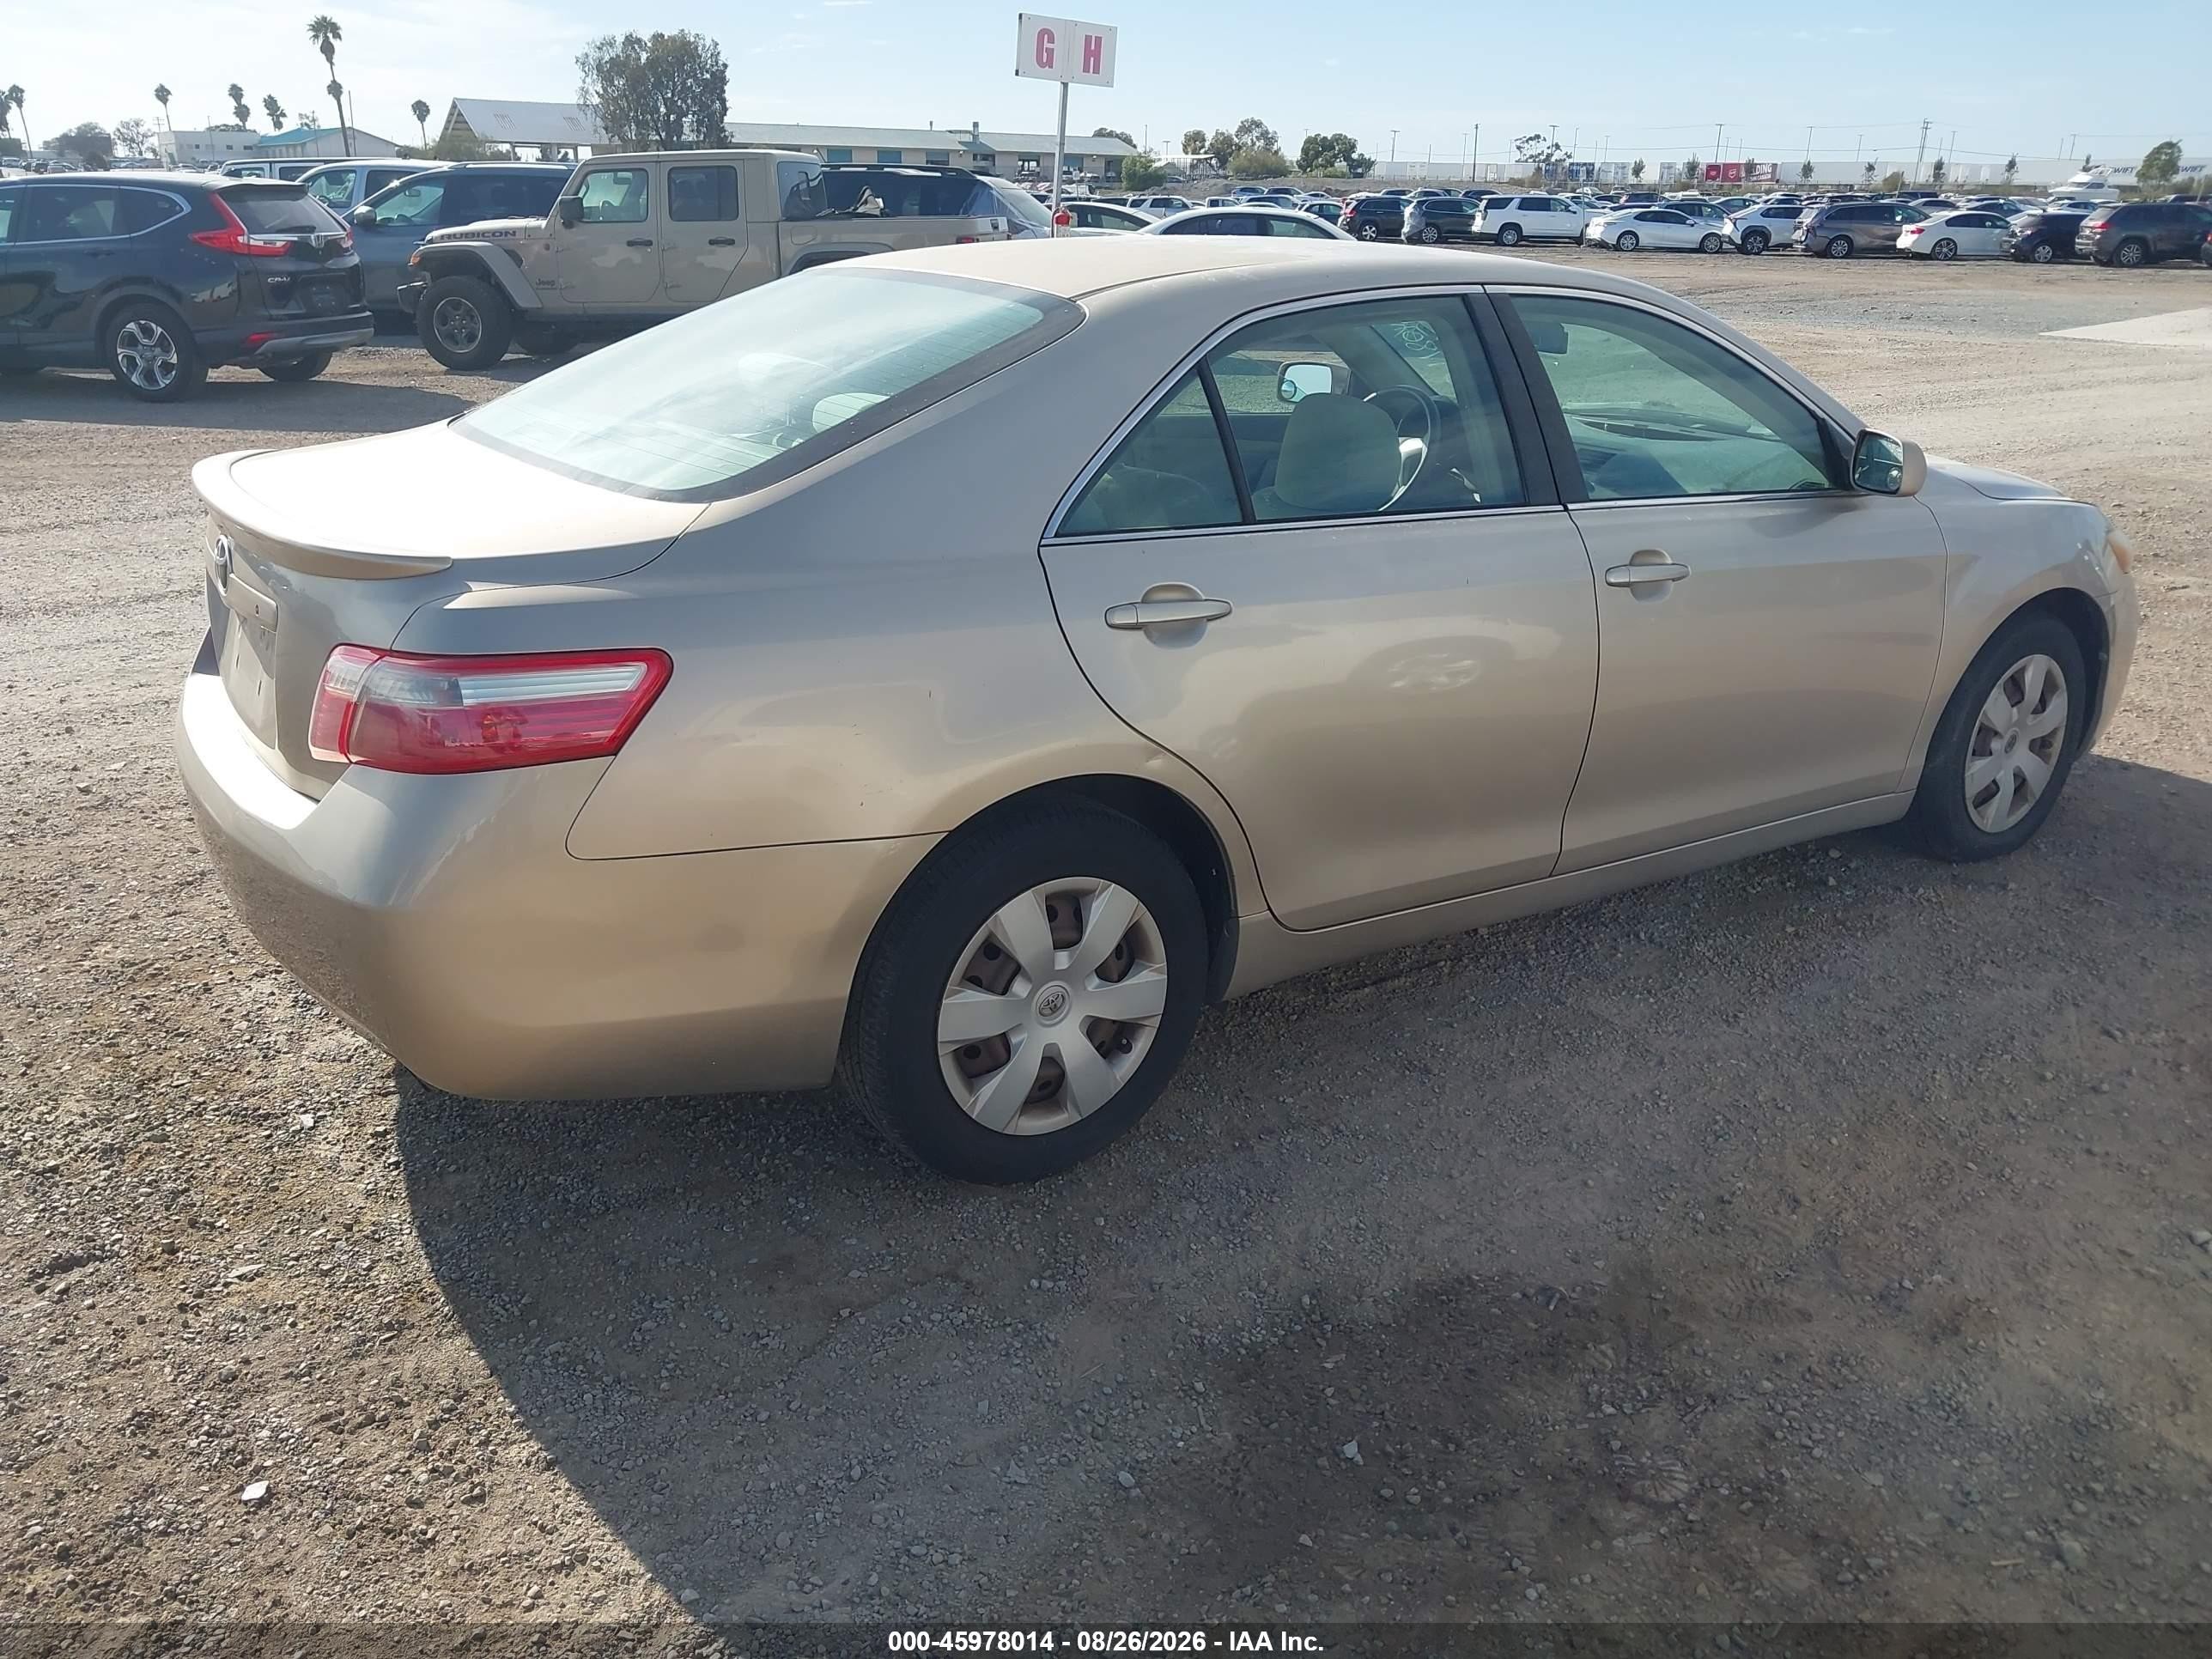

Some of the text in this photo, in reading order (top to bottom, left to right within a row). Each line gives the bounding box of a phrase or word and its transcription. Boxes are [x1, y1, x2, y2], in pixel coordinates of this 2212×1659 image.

[1036, 27, 1103, 75] G H
[440, 230, 517, 240] RUBICON
[536, 277, 556, 288] Jeep
